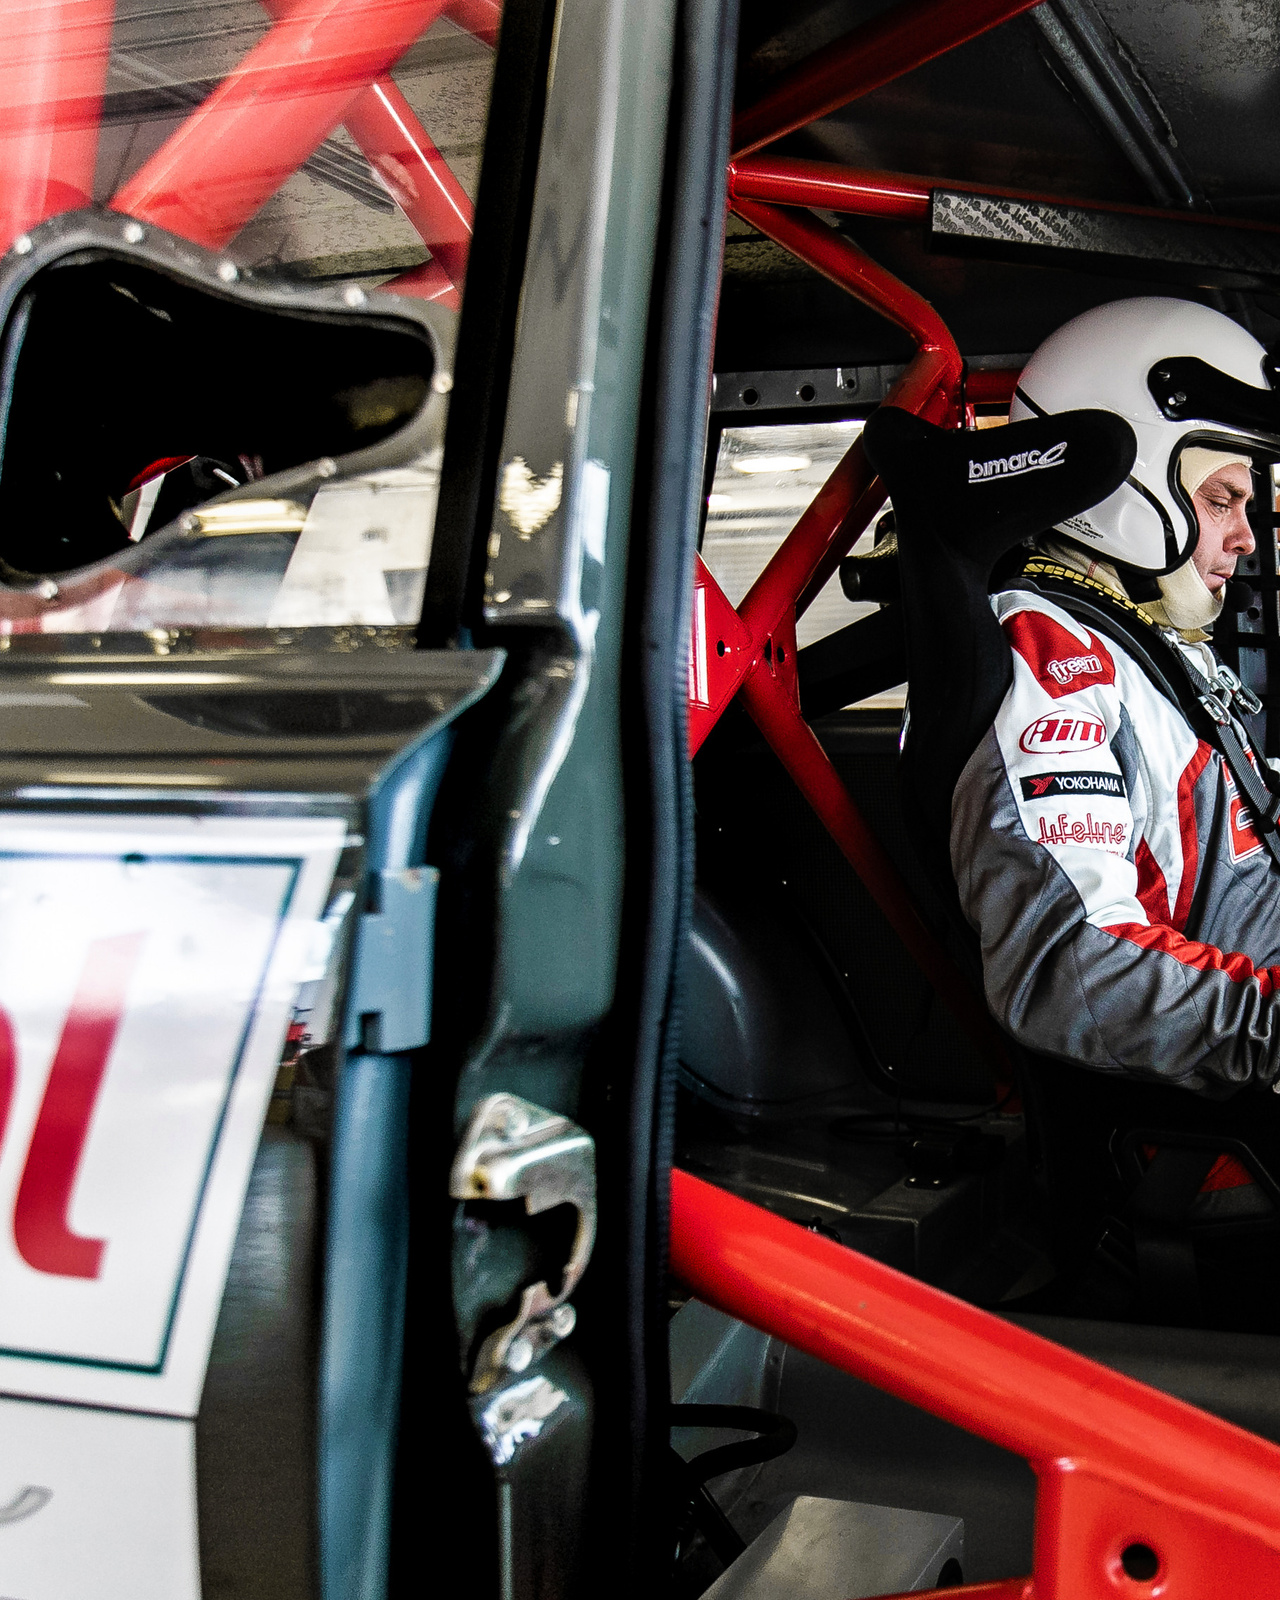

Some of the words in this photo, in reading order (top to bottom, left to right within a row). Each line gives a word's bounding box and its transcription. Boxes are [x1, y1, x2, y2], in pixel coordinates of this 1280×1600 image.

[1047, 655, 1103, 685] freem
[1054, 775, 1121, 793] YOKOHAMA
[1037, 812, 1128, 846] lifeline
